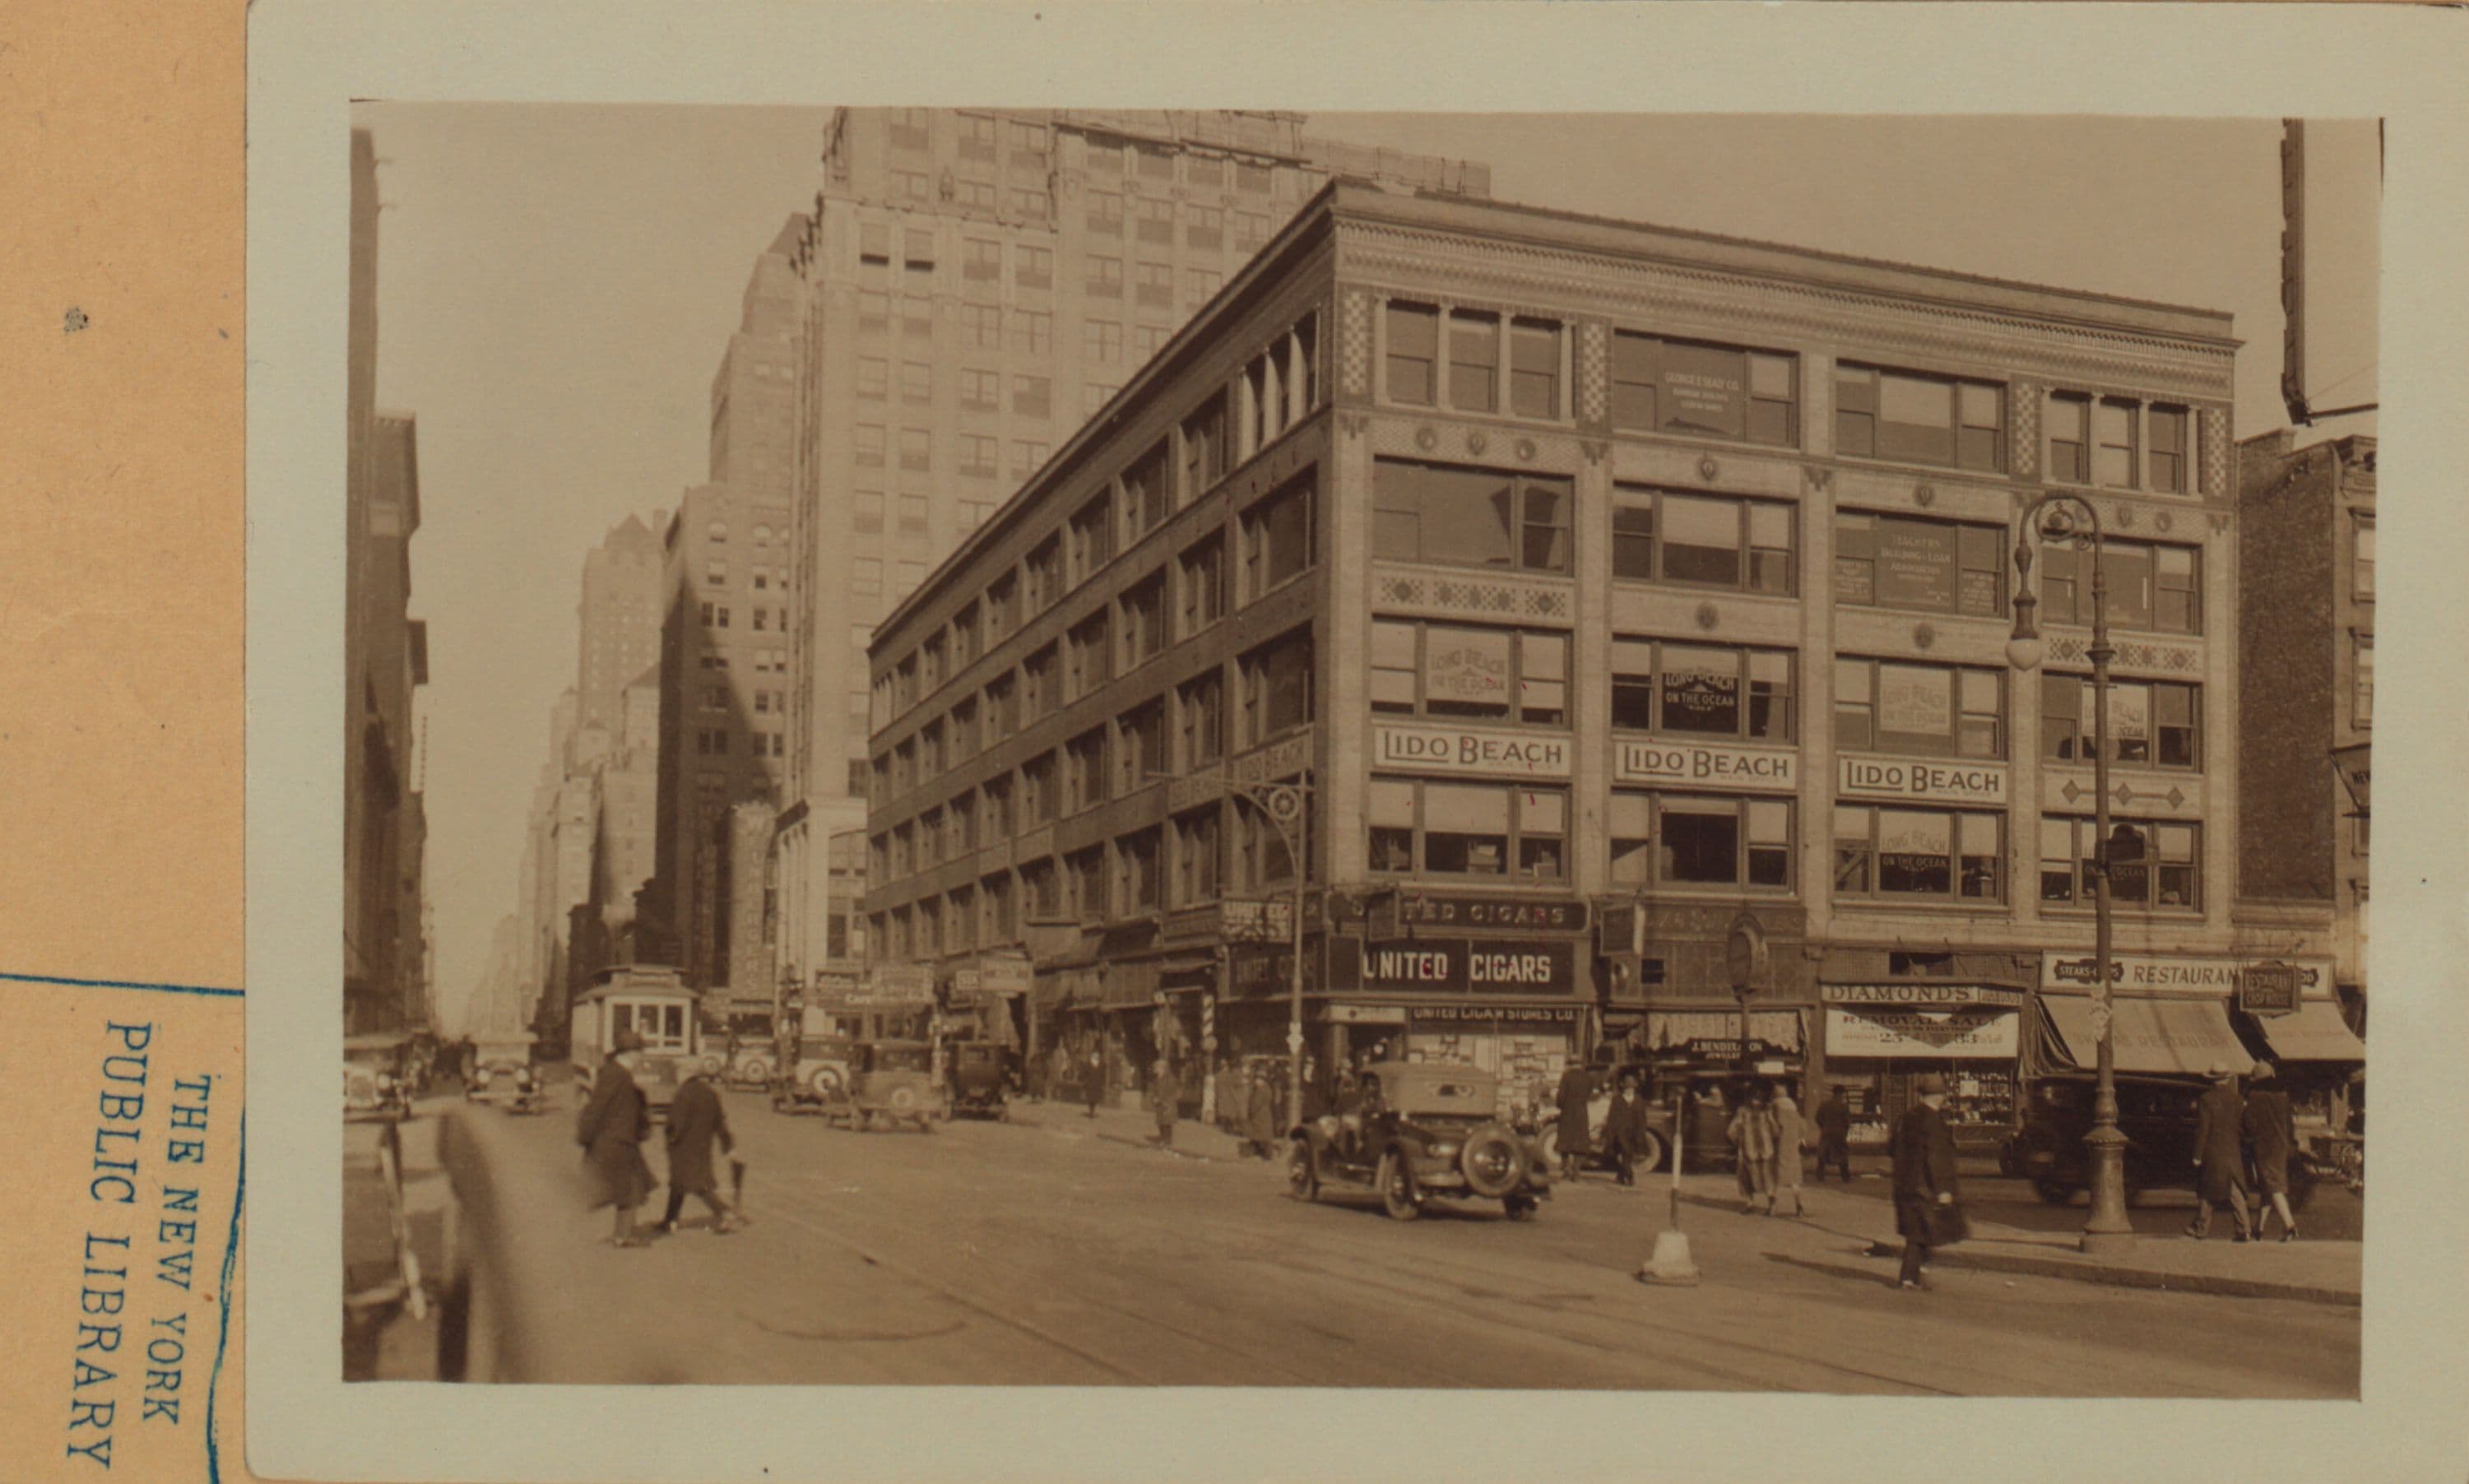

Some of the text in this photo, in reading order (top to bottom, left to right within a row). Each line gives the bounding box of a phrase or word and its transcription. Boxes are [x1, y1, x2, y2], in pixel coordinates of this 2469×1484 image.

[1665, 691, 1734, 707] ON THE OCEAN
[1385, 730, 1562, 764] LIDO BEACH
[1625, 744, 1788, 778] LIDO BEACH
[1848, 761, 1998, 792] LIDO BEACH
[1351, 900, 1565, 925] UTED CIGARS
[1362, 951, 1552, 982] UNITED CIGARS
[2133, 965, 2231, 985] RESTAURAN
[1831, 986, 1970, 1001] DIAMONDS
[67, 1019, 152, 1469] PUBLIC LIBRARY
[142, 1074, 211, 1426] THE NEW YORK
